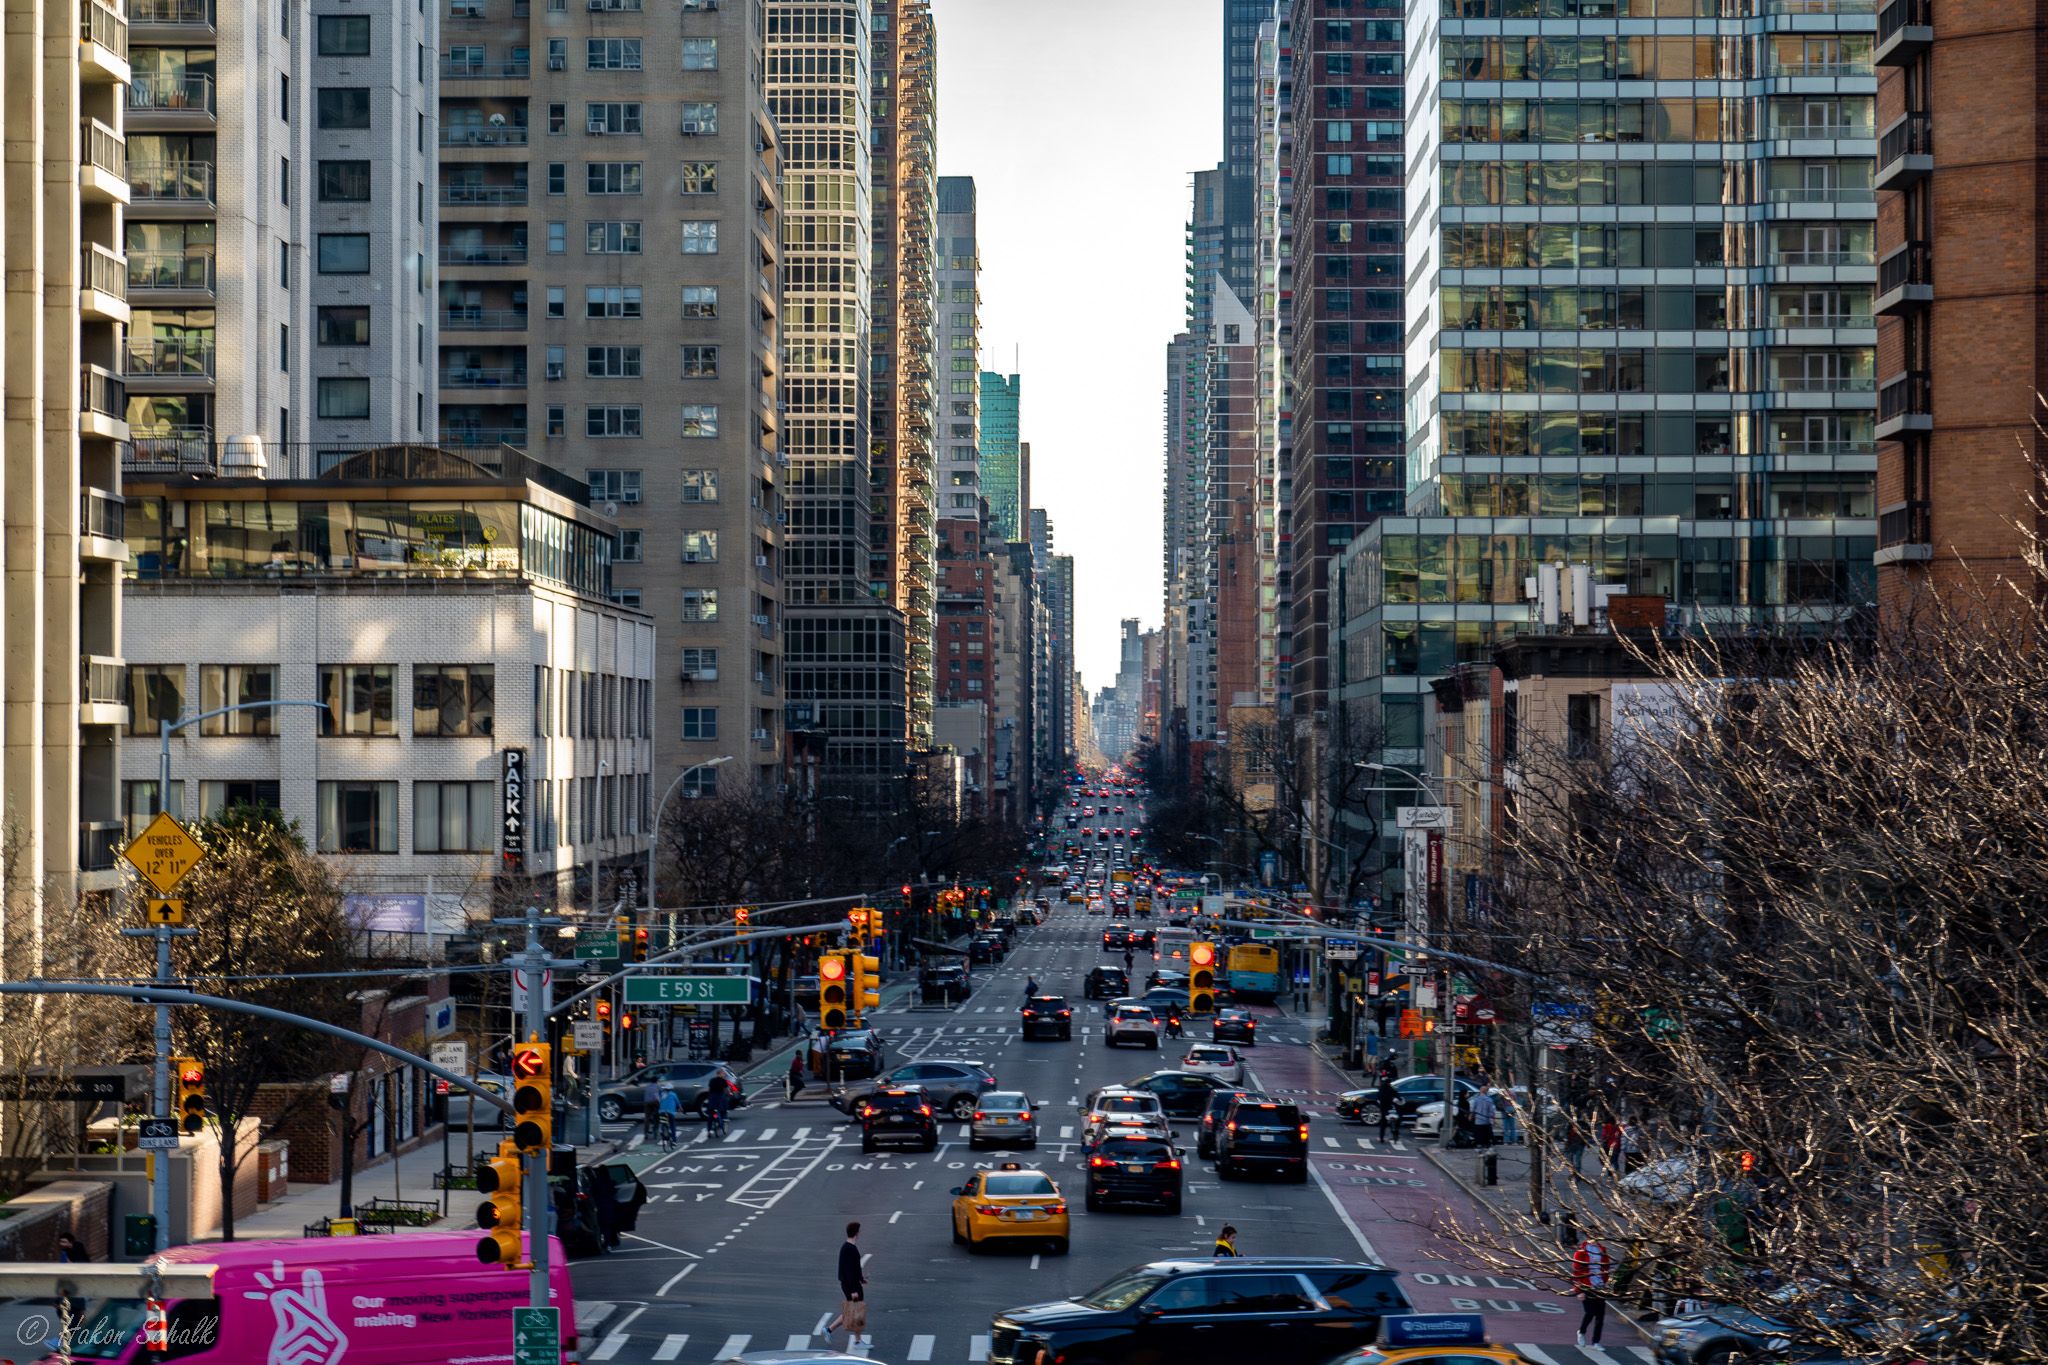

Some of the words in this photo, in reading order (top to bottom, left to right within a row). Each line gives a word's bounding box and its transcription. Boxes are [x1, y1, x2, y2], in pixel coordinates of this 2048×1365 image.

[416, 513, 455, 524] PILATES
[505, 752, 520, 814] PARK
[147, 835, 183, 845] VEHICLES
[154, 848, 175, 858] OVER
[659, 982, 669, 997] E
[674, 982, 693, 998] 59
[698, 982, 715, 998] St
[94, 1083, 114, 1093] 300
[141, 1138, 157, 1147] BIKE
[159, 1138, 177, 1147] LANE
[655, 1164, 755, 1174] ONLY
[826, 1162, 918, 1171] ONLY
[947, 1162, 1042, 1170] ONY
[1327, 1163, 1417, 1175] ONLY
[1350, 1177, 1427, 1187] BUS
[1413, 1272, 1539, 1291] ONLY
[352, 1295, 386, 1308] Our
[389, 1293, 446, 1306] moving
[450, 1289, 531, 1304] superpowe
[1451, 1297, 1565, 1314] BUS
[354, 1312, 417, 1328] making
[420, 1312, 451, 1323] New
[1413, 1320, 1471, 1332] StreetEasy
